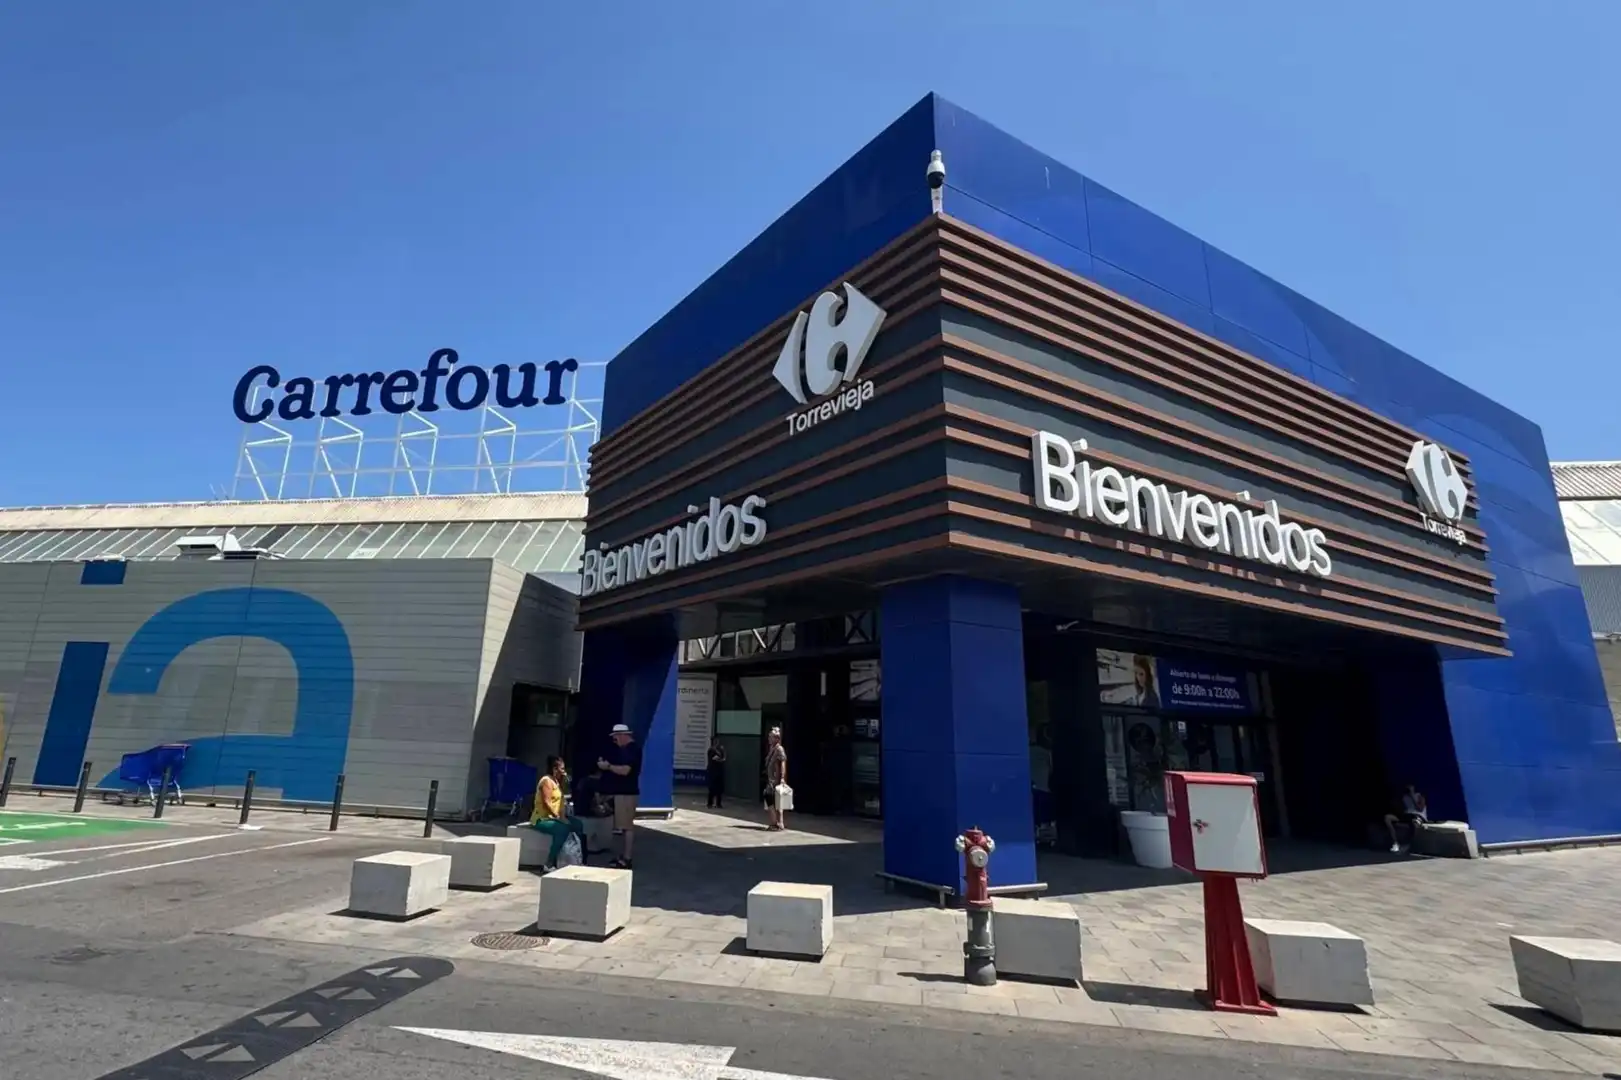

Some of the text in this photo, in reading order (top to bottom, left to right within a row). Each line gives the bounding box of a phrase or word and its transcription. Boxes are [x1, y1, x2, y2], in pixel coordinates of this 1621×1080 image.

[232, 348, 579, 424] Carrefour
[786, 378, 875, 436] Torrevieja
[1032, 430, 1332, 576] Bienvenidos
[581, 494, 767, 596] Bienvenidos
[1172, 682, 1183, 694] de
